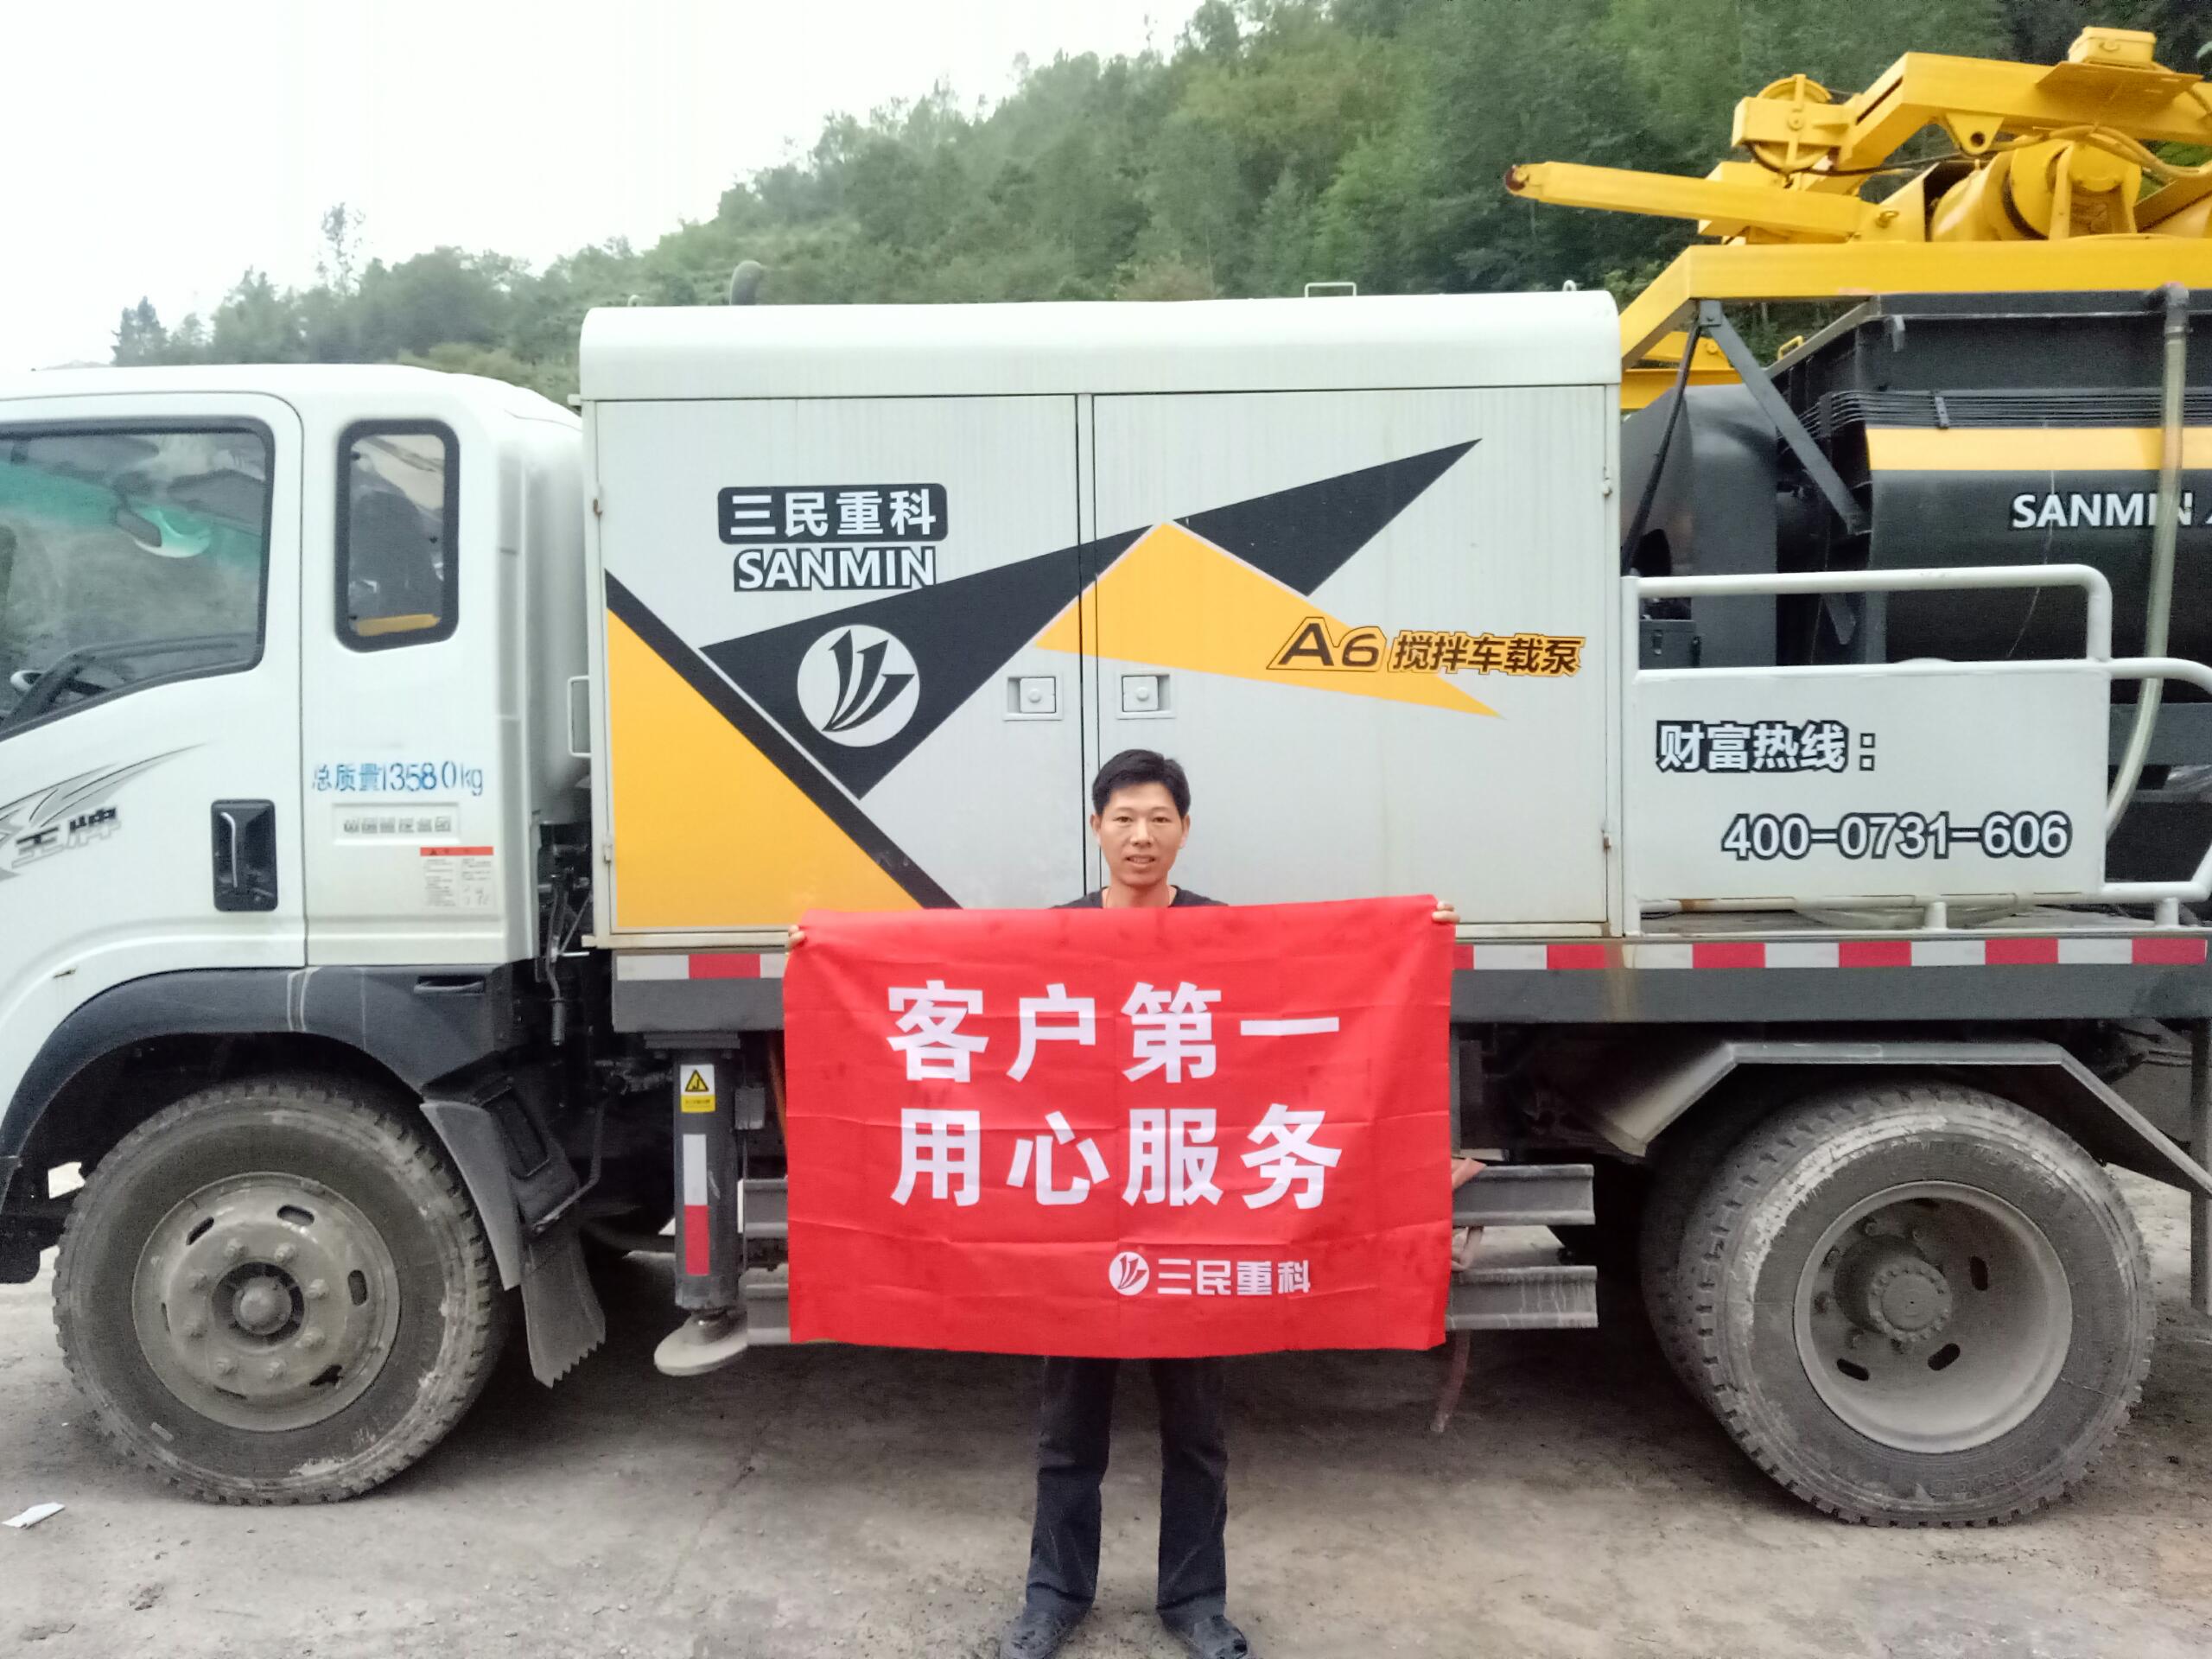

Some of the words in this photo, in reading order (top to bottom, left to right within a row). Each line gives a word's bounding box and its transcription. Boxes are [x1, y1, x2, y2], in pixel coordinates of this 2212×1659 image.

[729, 488, 937, 537] 三民重科
[735, 546, 936, 590] SANMIN
[1277, 621, 1379, 669] A6
[1391, 632, 1583, 676] 搅拌车载泵
[1722, 812, 2073, 861] 400-0731-606
[887, 980, 1340, 1084] 客户第一
[890, 1103, 1342, 1210] 用心服务
[1156, 1257, 1312, 1297] 三民重科
